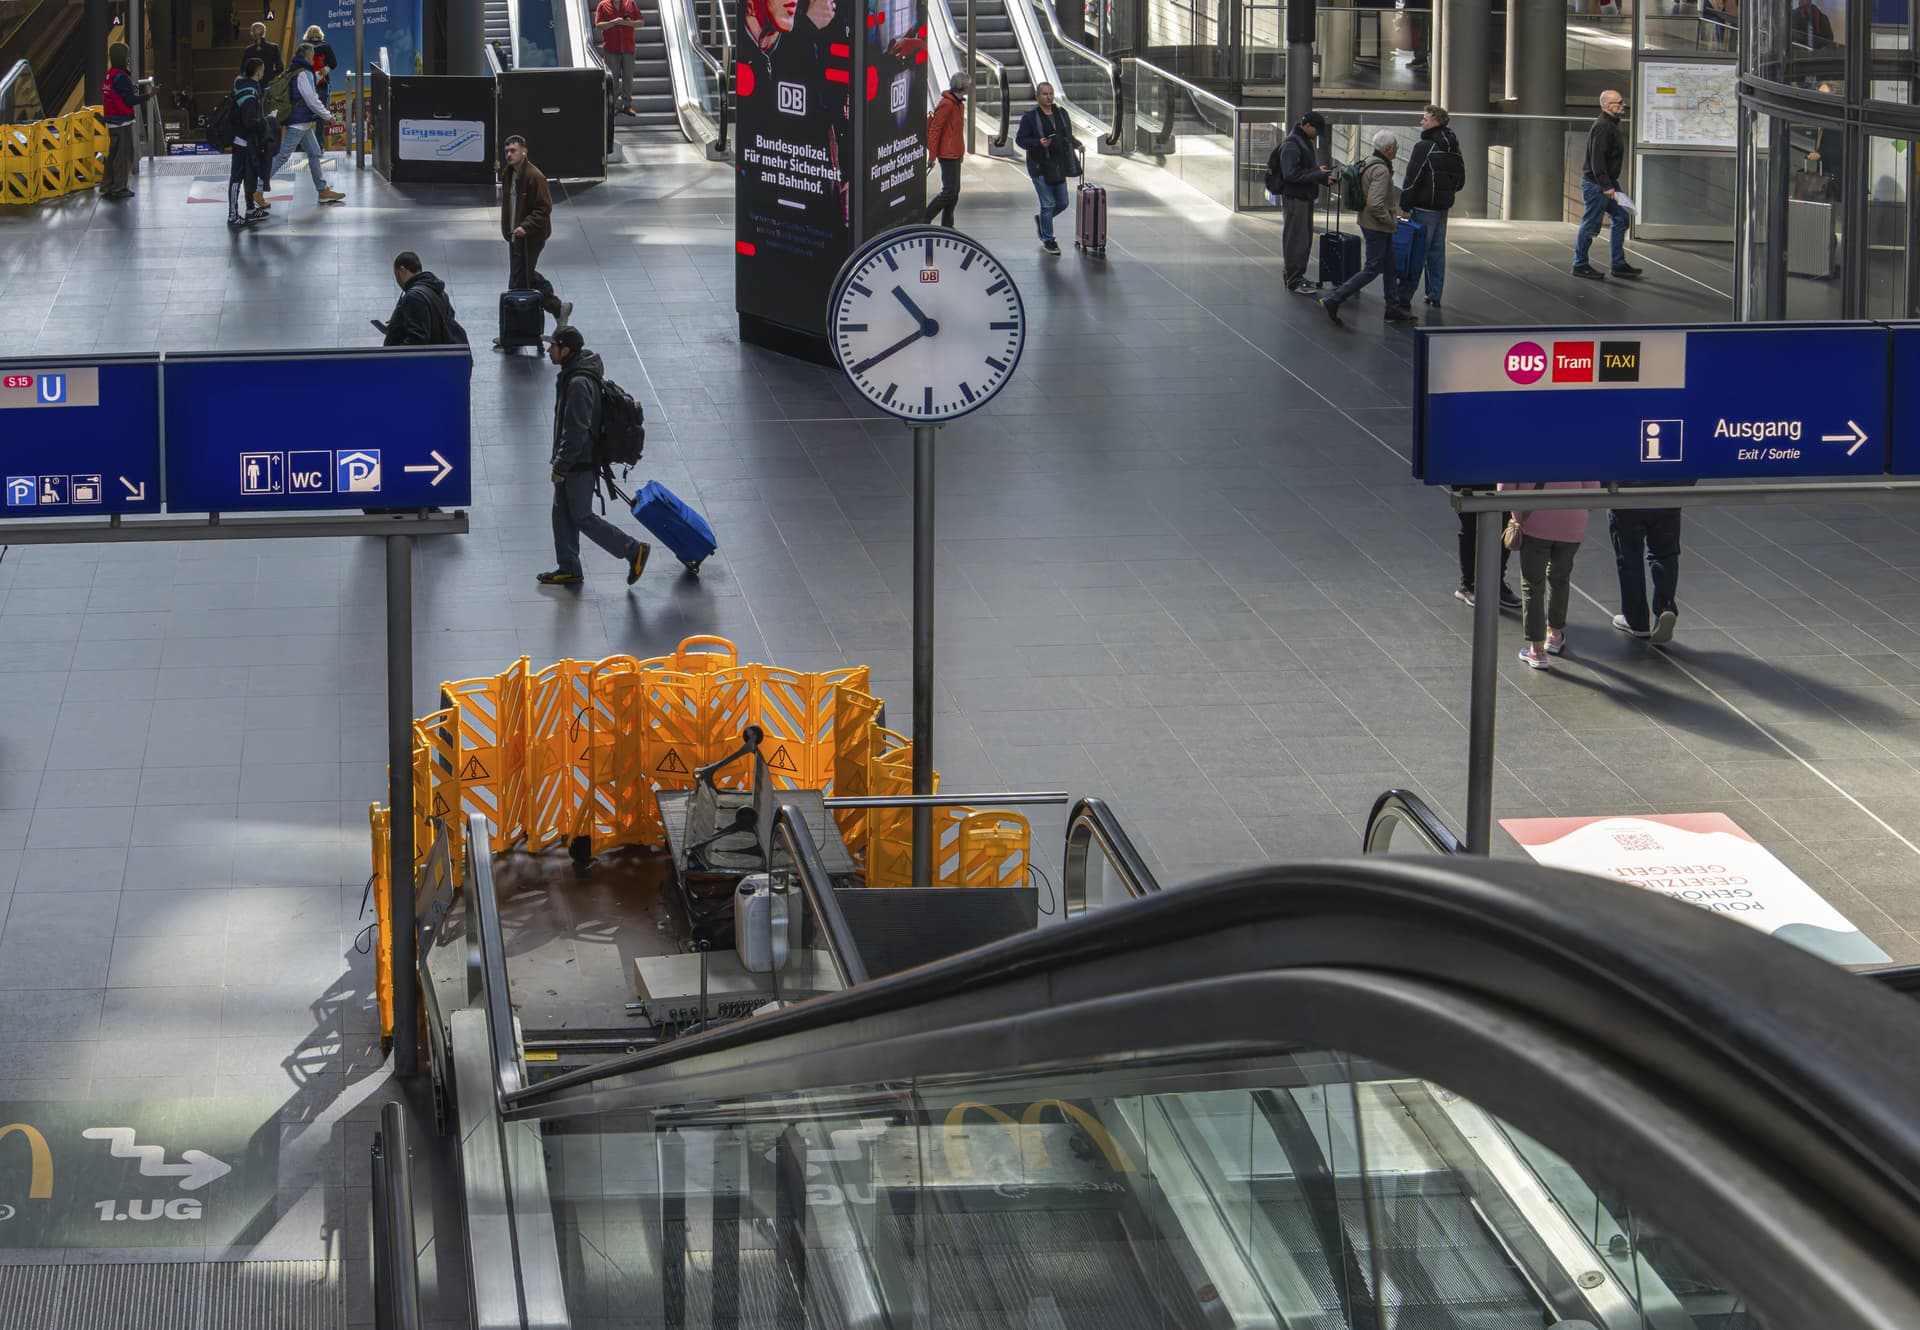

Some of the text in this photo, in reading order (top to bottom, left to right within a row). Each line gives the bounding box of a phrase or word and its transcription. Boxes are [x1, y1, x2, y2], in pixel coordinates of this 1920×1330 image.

[780, 86, 804, 111] DB
[329, 125, 344, 135] NEU
[402, 127, 457, 138] Geyssel
[756, 134, 829, 162] Bundespolizei.
[878, 143, 893, 161] Mehr
[744, 148, 842, 182] Für mehr Sicherheit
[871, 144, 924, 180] Für mehr Sicherheit
[761, 171, 824, 195] am Bahnhof.
[880, 179, 890, 193] am
[922, 271, 937, 282] DB
[1507, 355, 1545, 372] BUS
[1556, 355, 1592, 369] Tram
[1603, 354, 1636, 368] TAXI
[8, 377, 29, 387] S 15
[42, 376, 61, 402] U
[1714, 418, 1802, 442] Ausgang
[1737, 449, 1759, 460] Exit
[1768, 448, 1801, 460] Sortie
[292, 472, 323, 489] WC
[1623, 876, 1749, 889] GESETZLIC
[1666, 888, 1753, 902] GEHÖR
[94, 1199, 203, 1222] 1.UG
